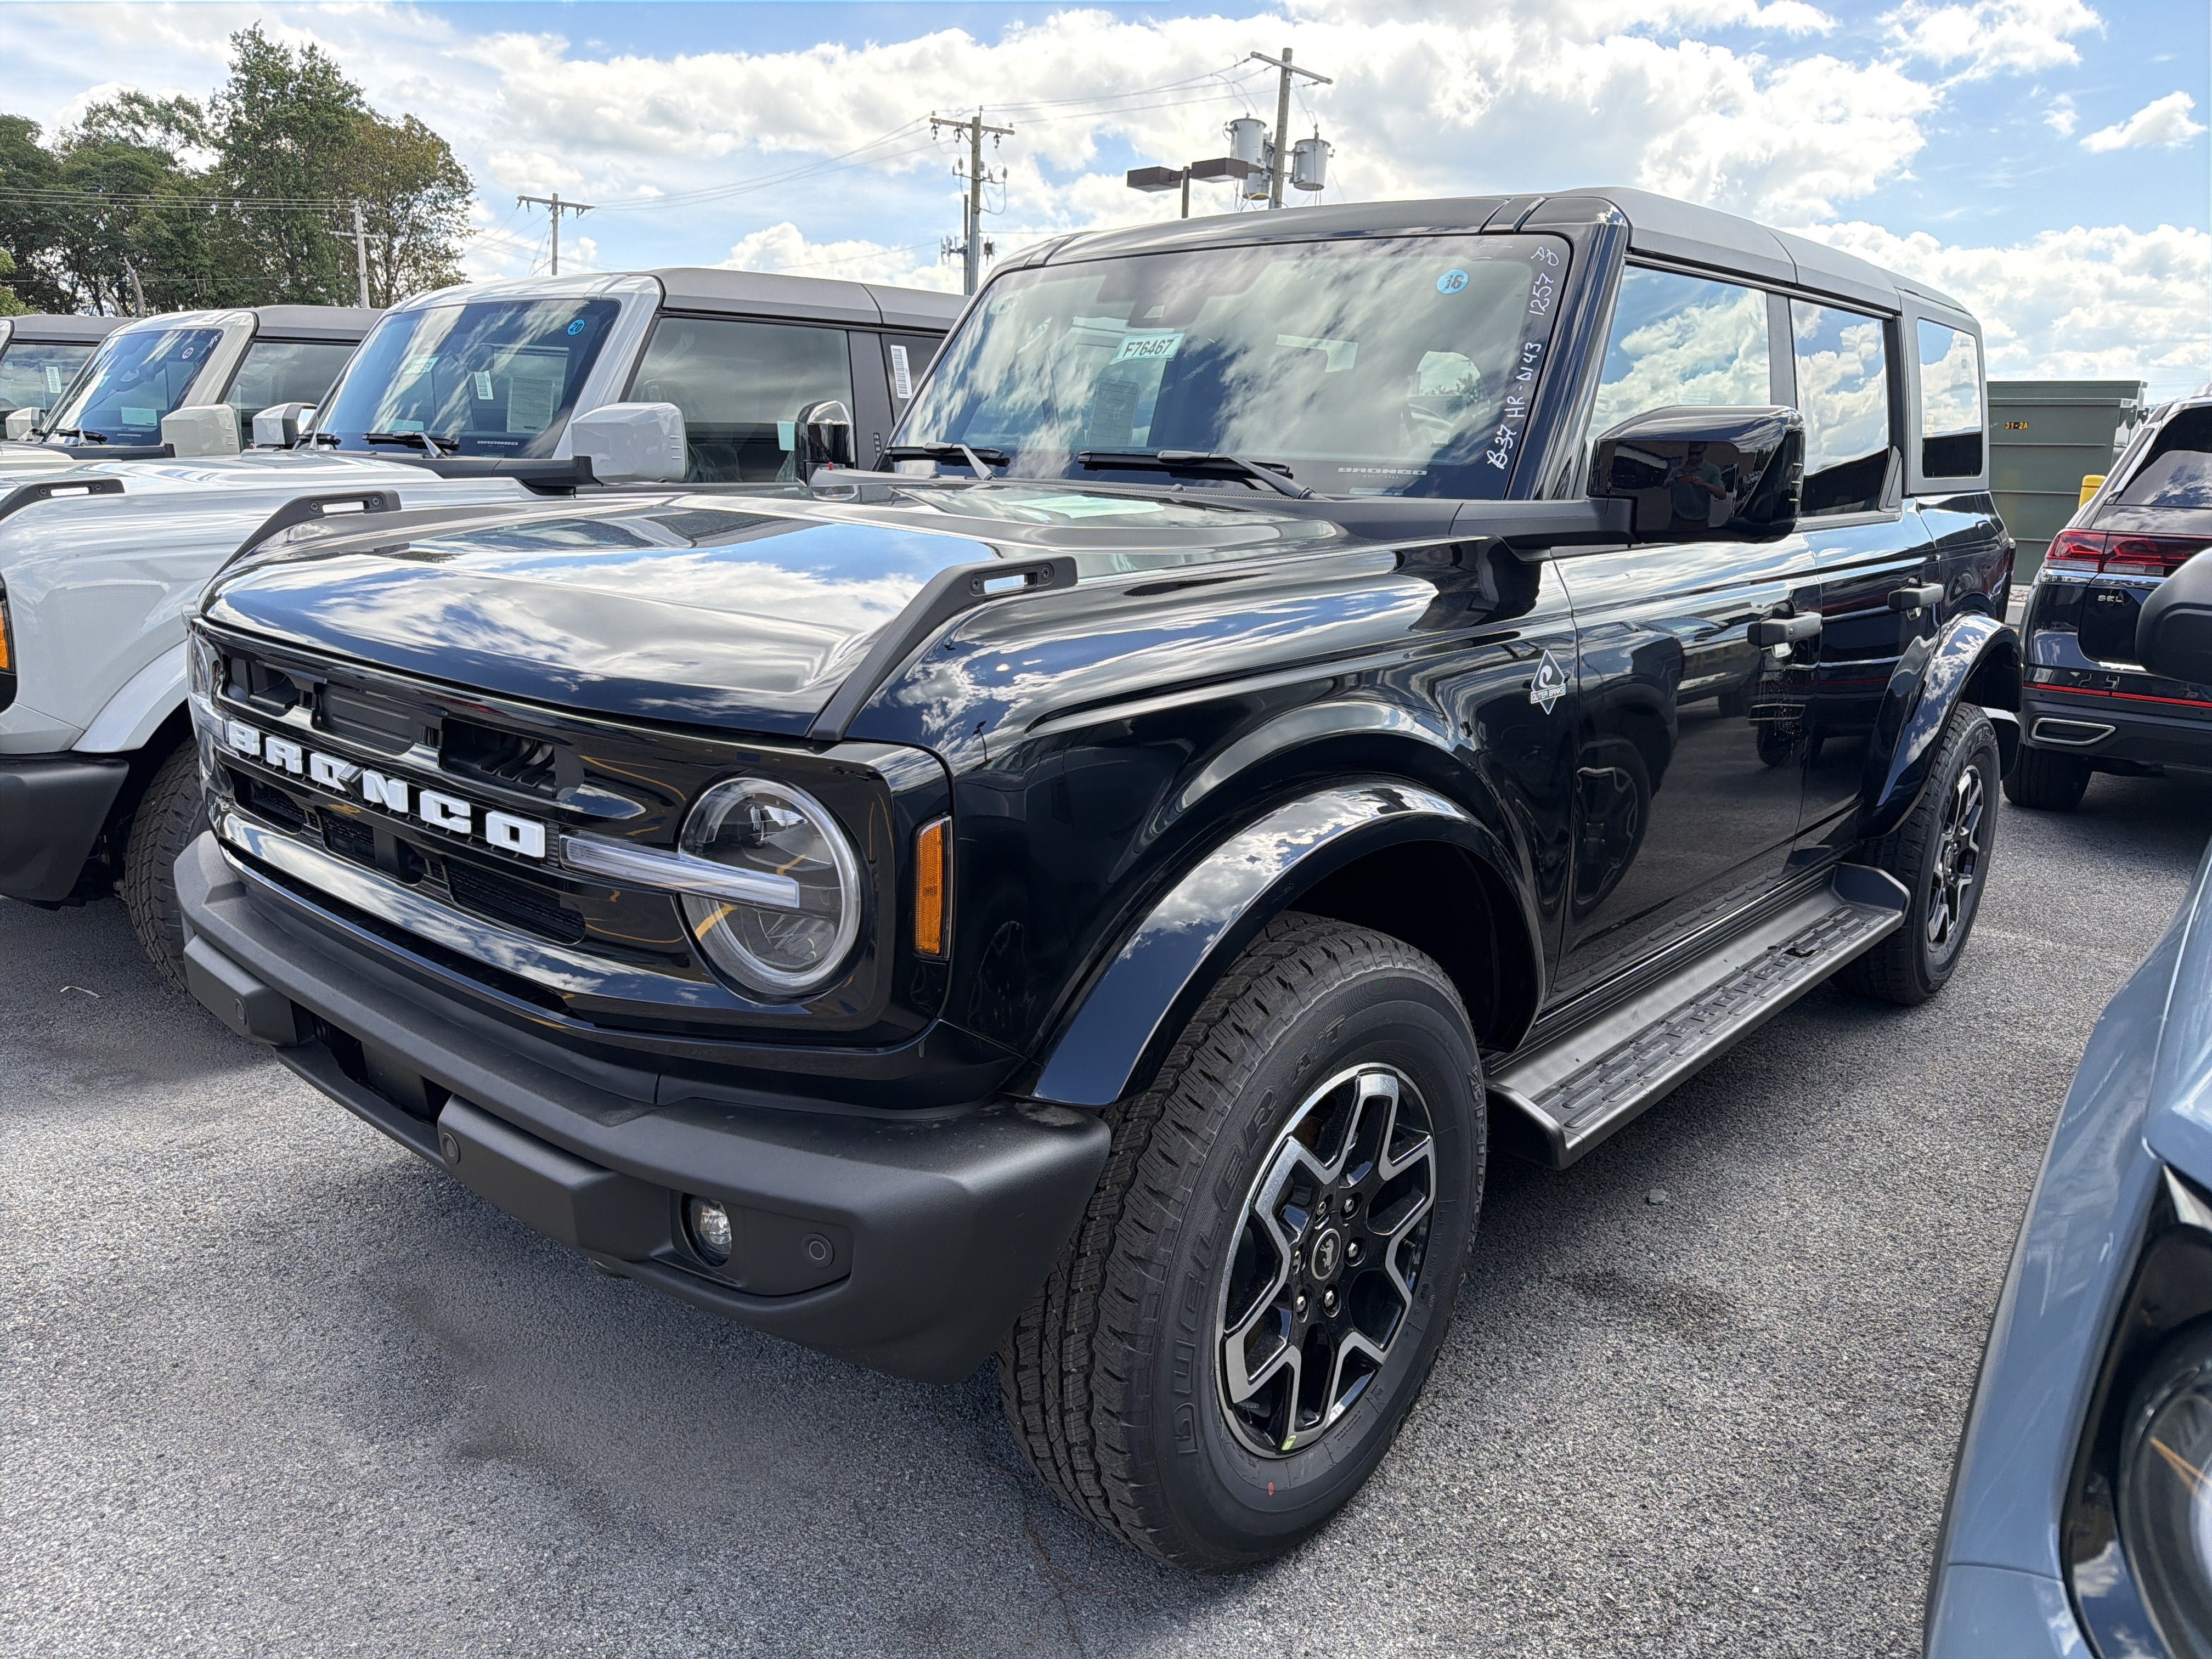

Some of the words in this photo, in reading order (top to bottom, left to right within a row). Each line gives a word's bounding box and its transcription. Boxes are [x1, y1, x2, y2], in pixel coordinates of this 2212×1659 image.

[1529, 273, 1554, 315] 1257
[569, 323, 583, 332] 20
[1122, 339, 1176, 358] F76467
[1338, 467, 1427, 476] BRONCO
[2097, 595, 2123, 603] SEL
[1532, 692, 1548, 701] OUTER
[1549, 686, 1565, 696] BANKS
[228, 719, 546, 859] BRONCO
[1173, 1088, 1280, 1456] DUELER
[1290, 1014, 1348, 1085] A/T
